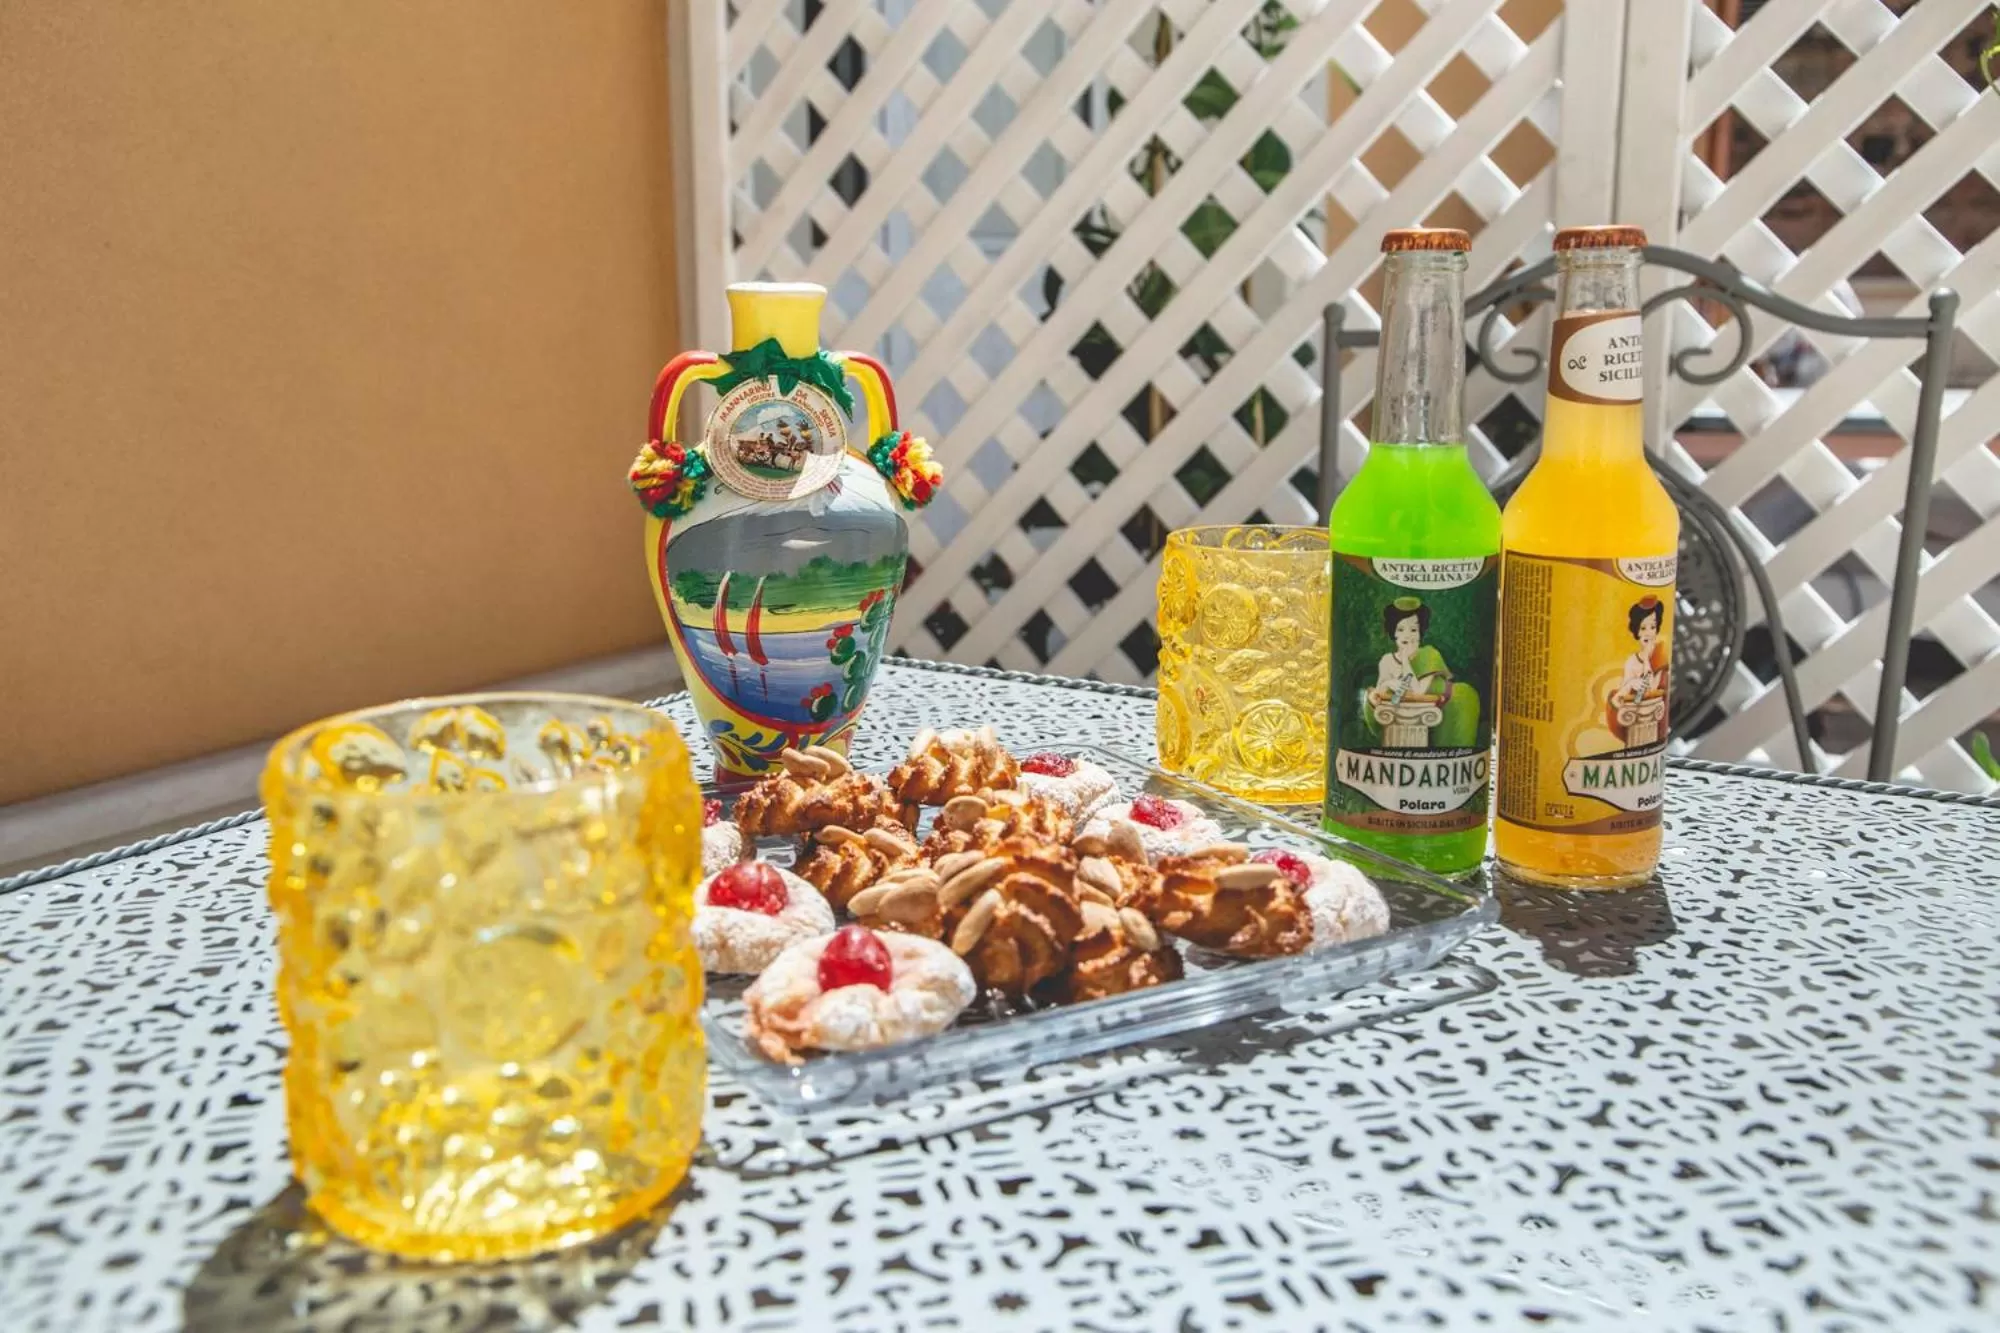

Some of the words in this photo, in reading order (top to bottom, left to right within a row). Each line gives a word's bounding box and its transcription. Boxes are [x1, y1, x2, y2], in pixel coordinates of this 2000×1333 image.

[819, 408, 838, 439] SICILIA
[1380, 561, 1428, 573] ANTICA
[1431, 561, 1480, 573] RICETTA
[1627, 561, 1663, 572] ANTICA
[1402, 572, 1464, 583] SICILIANA
[1346, 756, 1487, 788] MANDARINO
[1399, 799, 1446, 810] Polara
